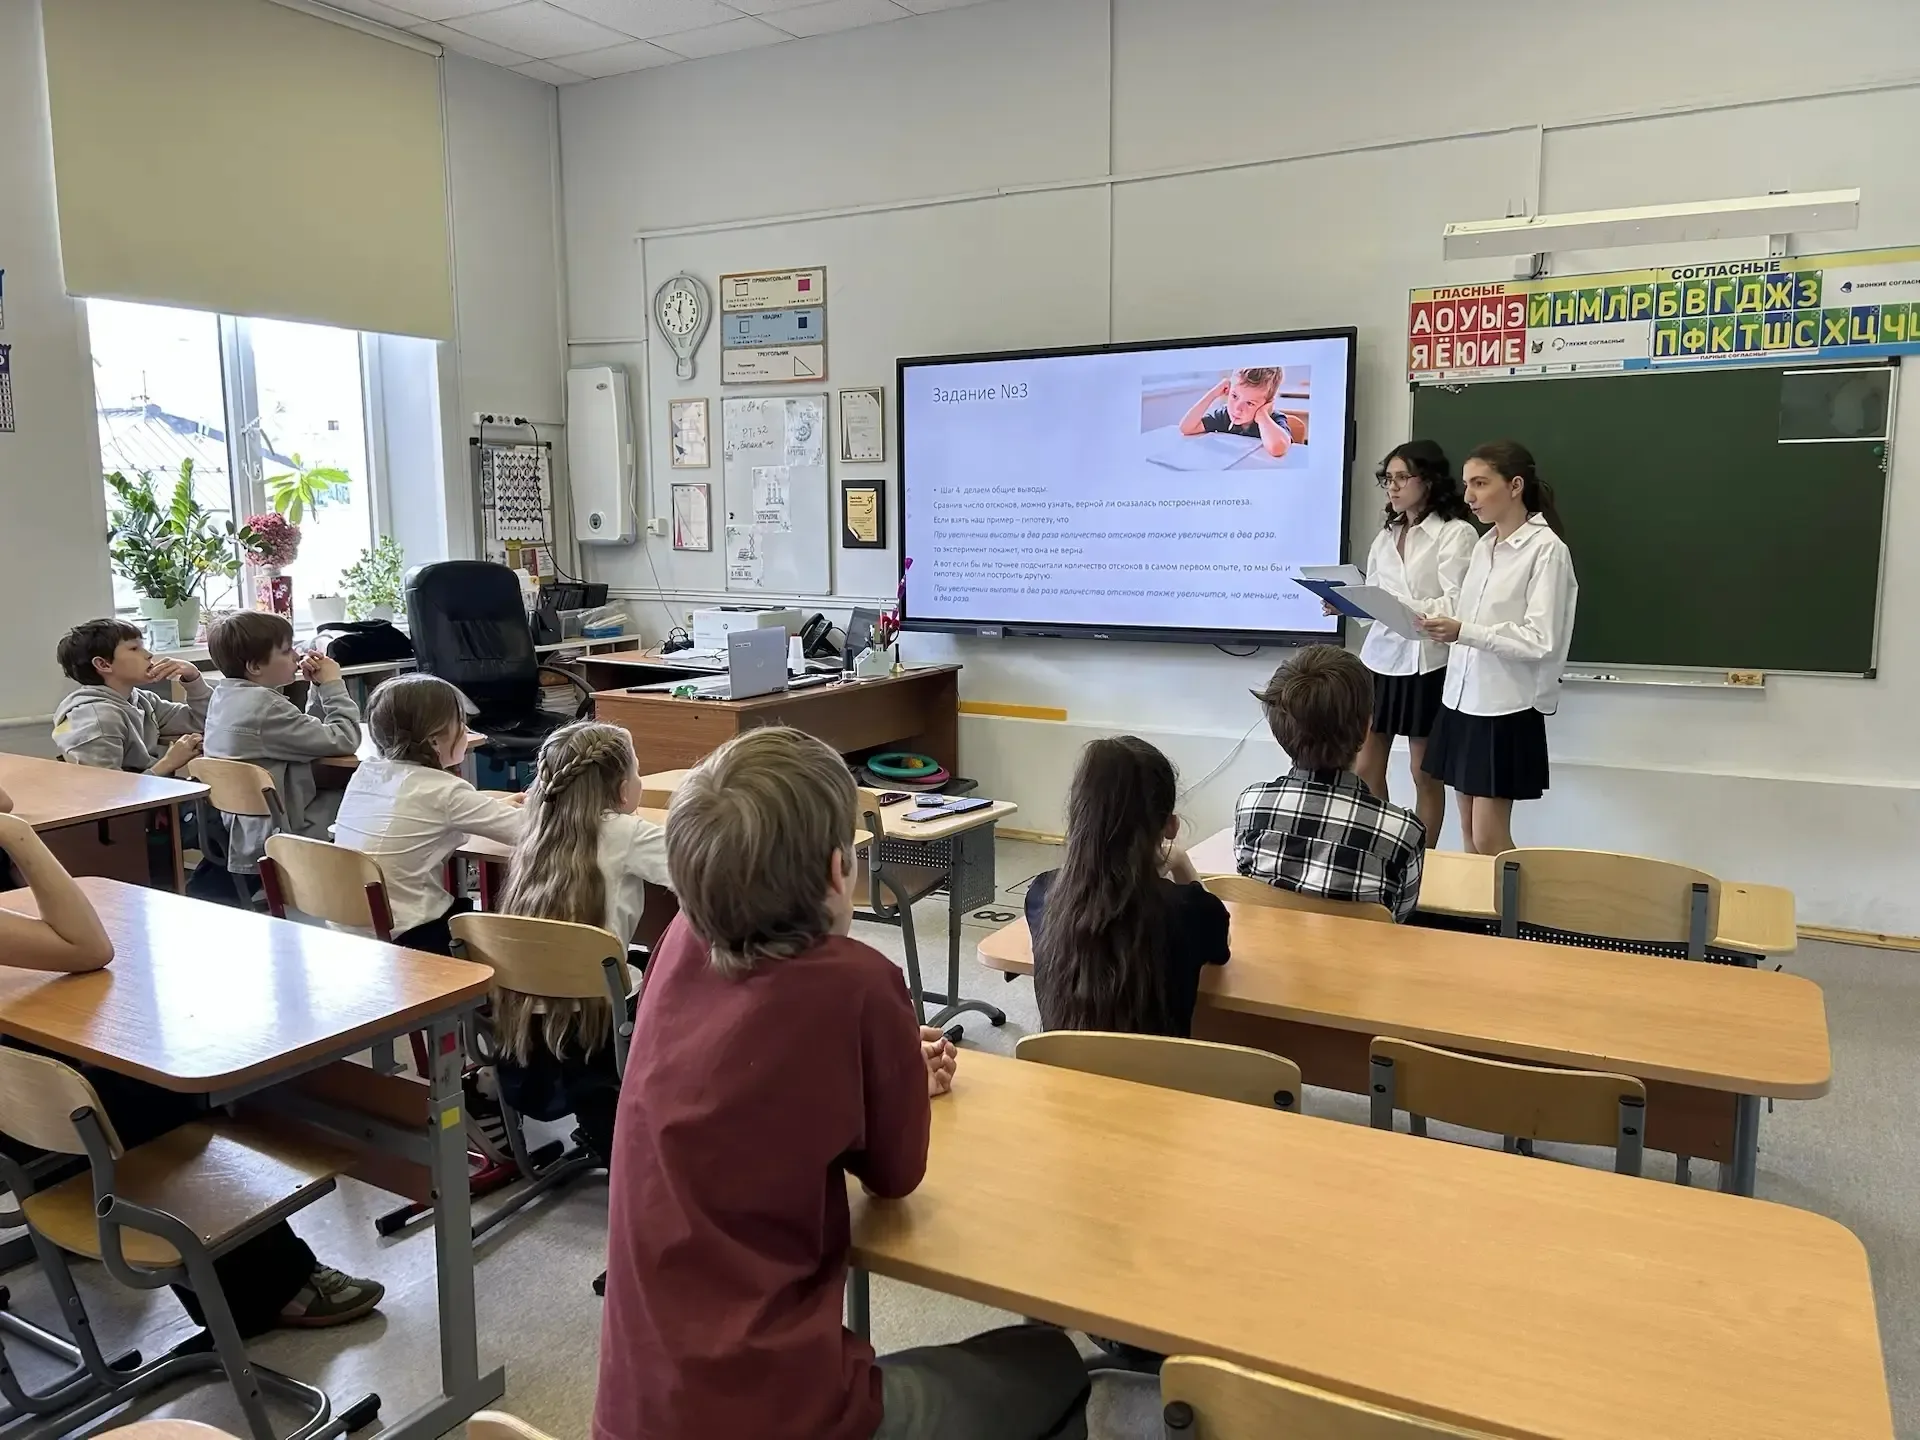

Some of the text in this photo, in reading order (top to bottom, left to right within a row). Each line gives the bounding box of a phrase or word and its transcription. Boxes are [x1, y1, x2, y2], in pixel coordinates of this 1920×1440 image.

[1671, 260, 1781, 280] СОГЛАСНЫЕ
[1433, 284, 1505, 300] ГЛАСНЫЕ
[932, 383, 1028, 404] Задание №3
[992, 486, 1016, 494] общие
[934, 501, 962, 509] Сравнив
[1048, 501, 1074, 509] узнать,
[1076, 500, 1103, 509] верной
[1159, 500, 1210, 508] построенная
[1213, 498, 1252, 507] гипотеза.
[1022, 517, 1055, 525] гипотезу,
[934, 531, 946, 539] При
[1178, 532, 1228, 540] увеличится
[1237, 530, 1252, 539] два
[1254, 532, 1276, 540] раза.
[1213, 564, 1241, 572] опыте,
[1270, 563, 1282, 571] бы
[1177, 591, 1228, 599] увеличится,
[1243, 592, 1279, 600] меньше,
